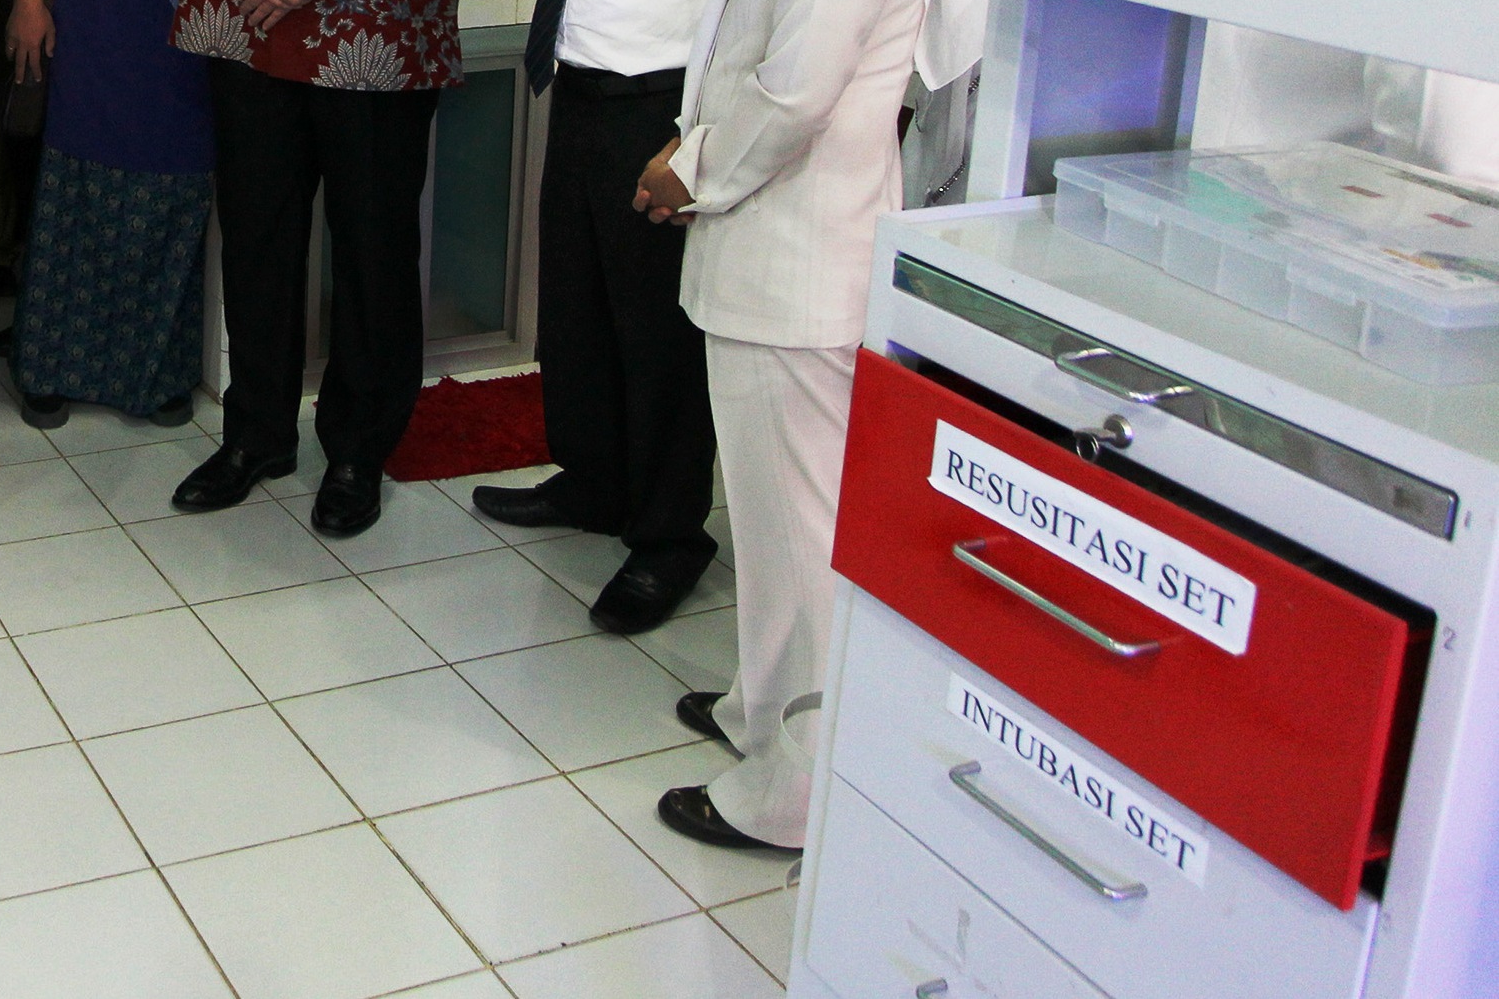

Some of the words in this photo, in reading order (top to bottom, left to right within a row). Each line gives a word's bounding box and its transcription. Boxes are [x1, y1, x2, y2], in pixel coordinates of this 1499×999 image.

[946, 448, 1150, 586] RESUSITASI
[1157, 563, 1236, 628] SET
[961, 689, 1117, 820] INTUBASI
[1124, 804, 1196, 872] SET
